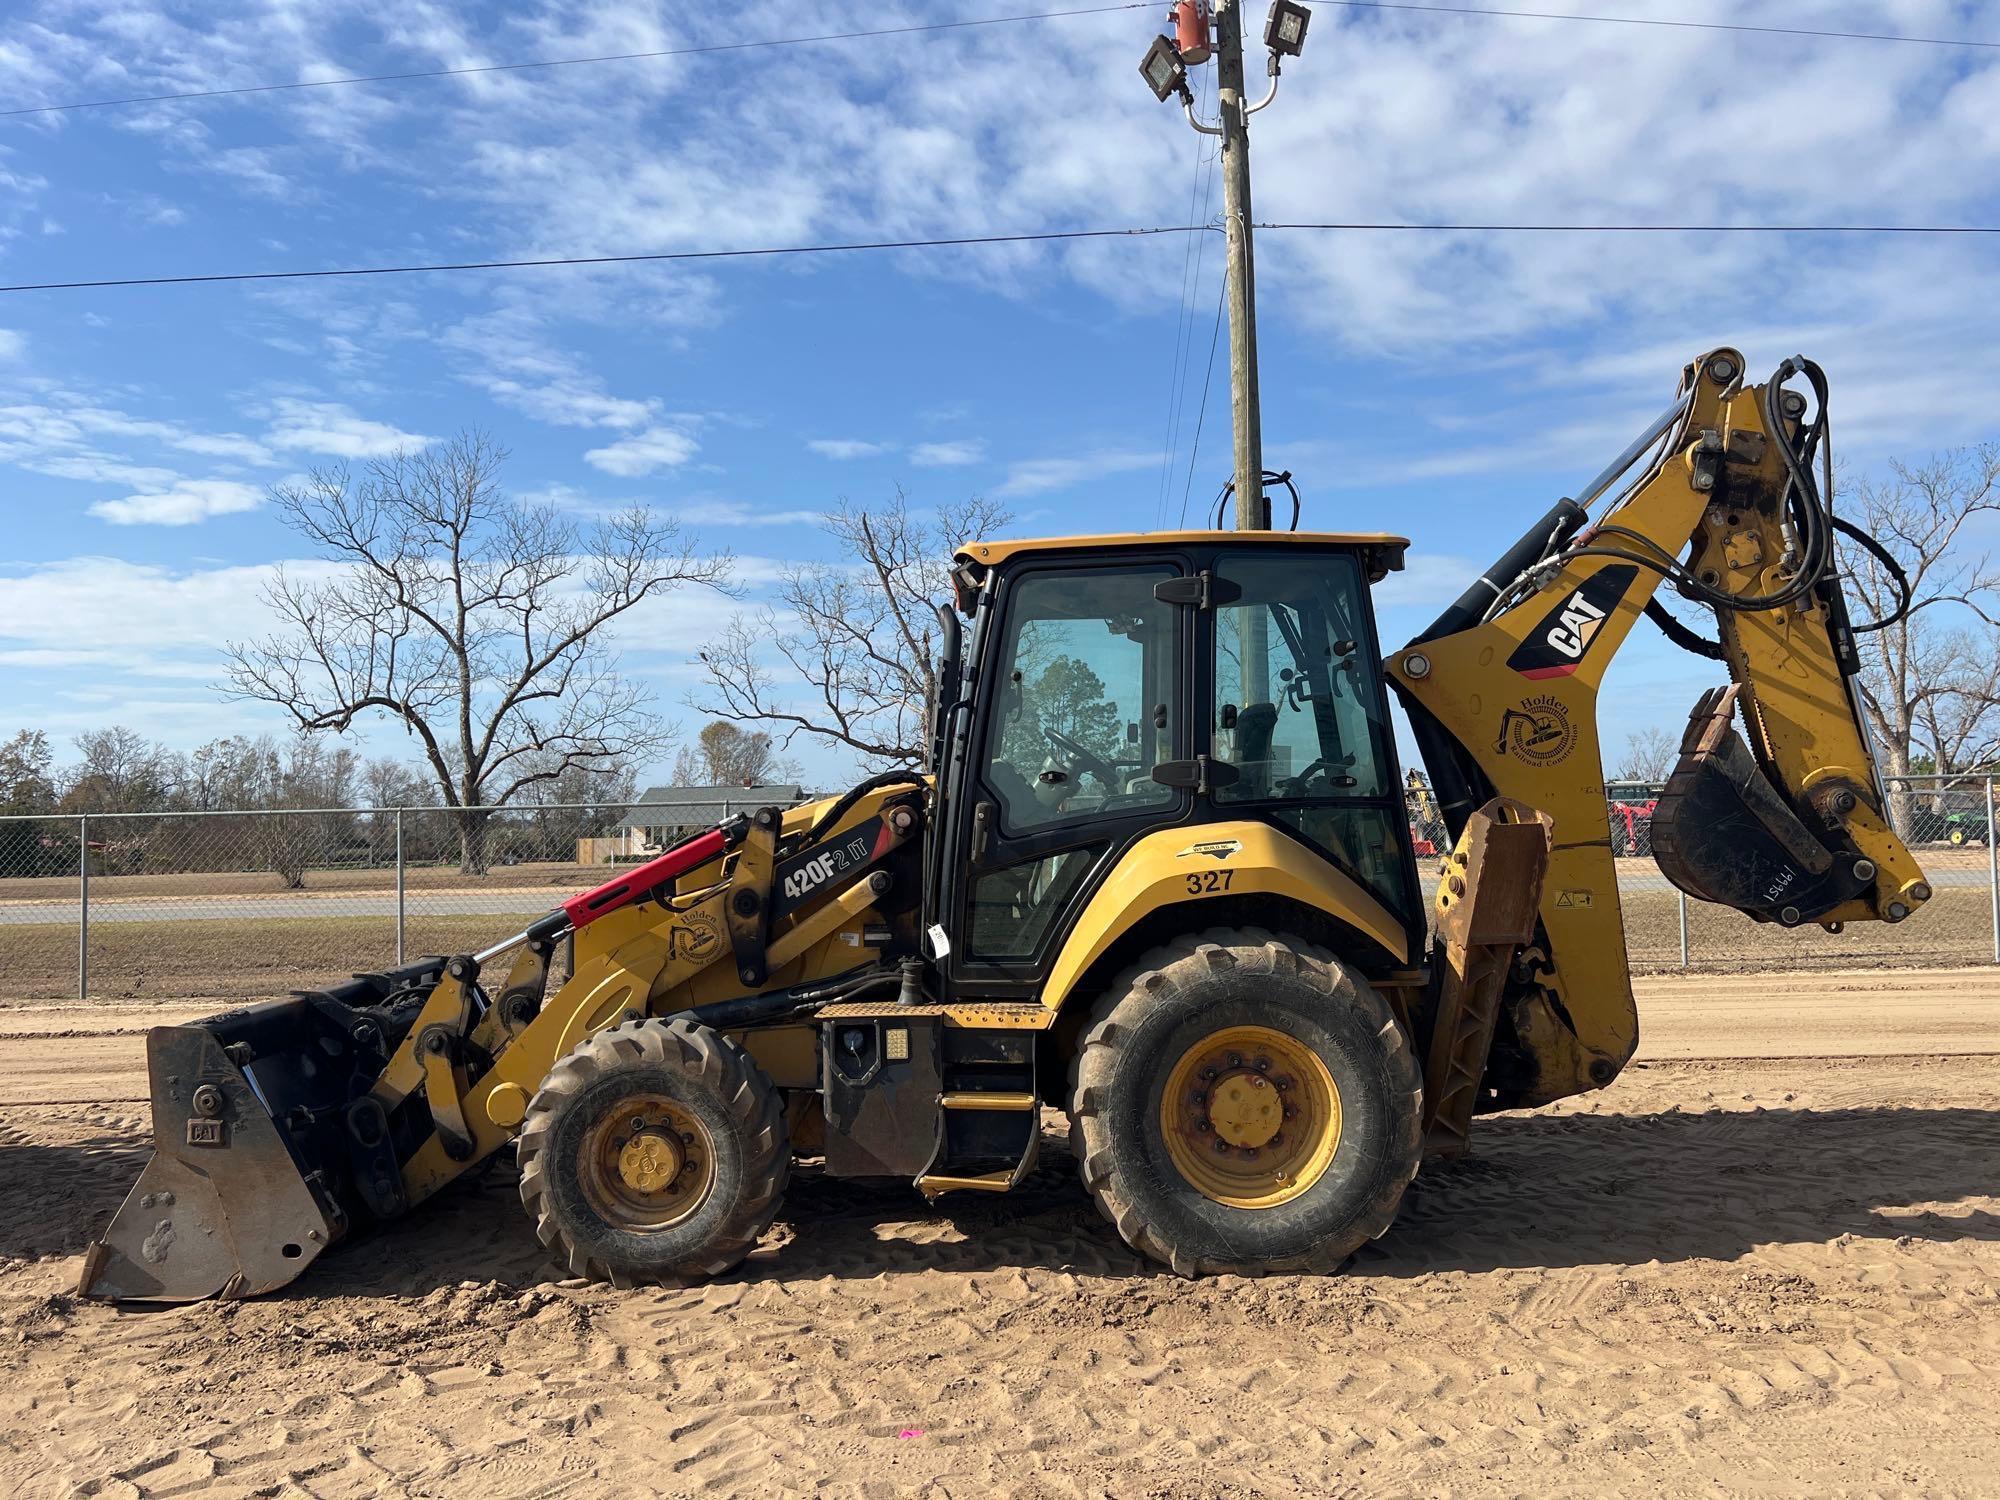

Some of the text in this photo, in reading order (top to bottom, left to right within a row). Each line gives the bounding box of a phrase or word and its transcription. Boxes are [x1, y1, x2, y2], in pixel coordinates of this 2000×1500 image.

[1547, 590, 1606, 658] CAT
[1520, 694, 1569, 715] Holden
[1510, 724, 1578, 768] Railroad Construction
[1186, 869, 1234, 895] 327
[681, 910, 717, 924] Holden
